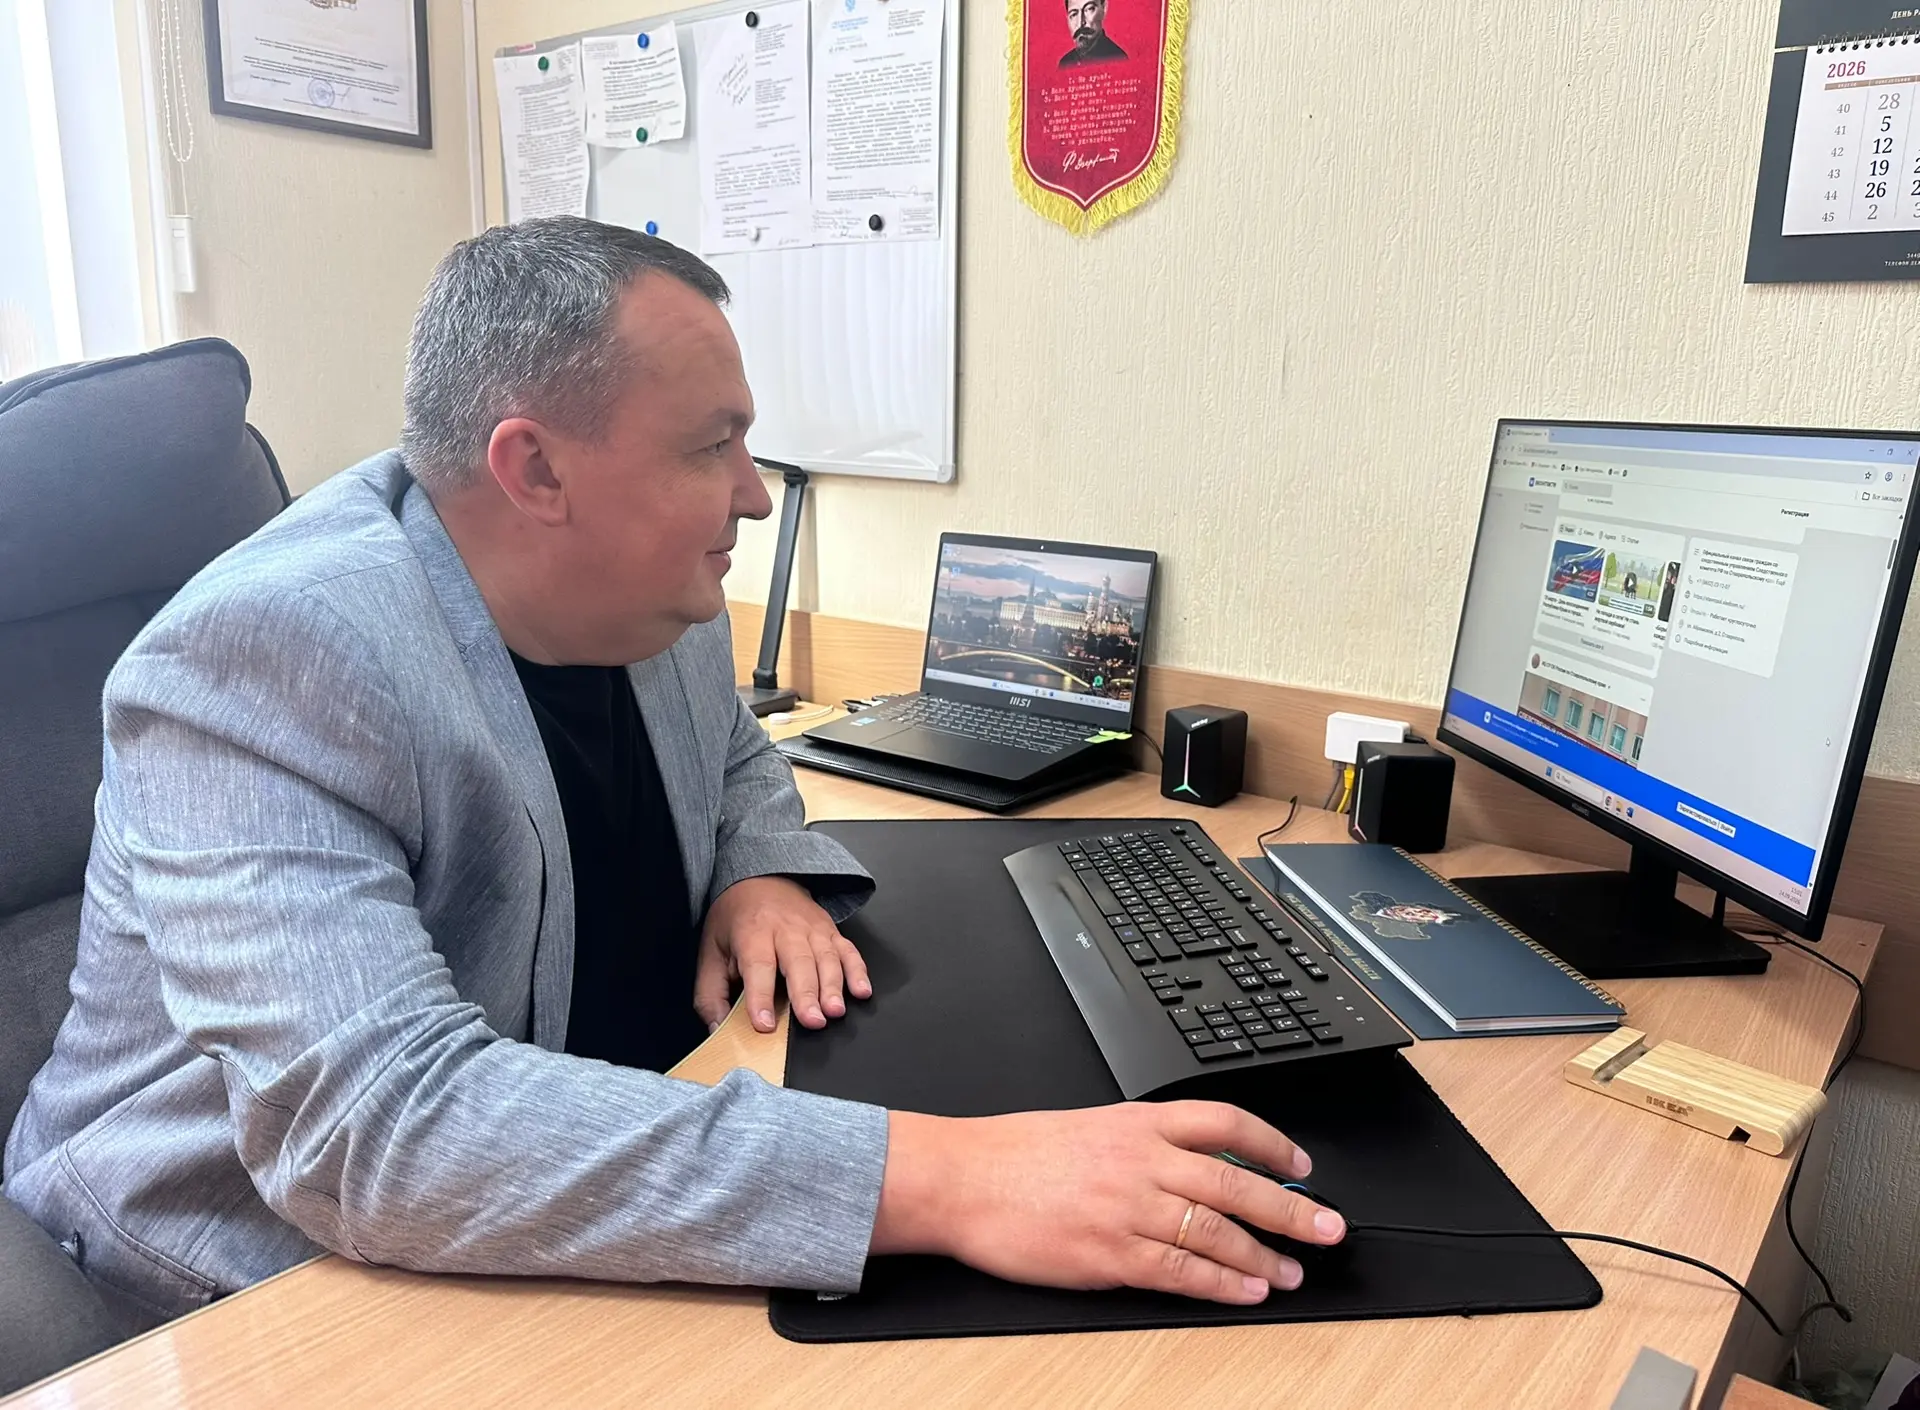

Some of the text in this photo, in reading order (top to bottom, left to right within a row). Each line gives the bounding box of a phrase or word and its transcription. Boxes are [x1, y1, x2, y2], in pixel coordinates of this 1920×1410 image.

[1890, 10, 1912, 20] ДЕНЬ
[1827, 60, 1866, 78] 2026
[1878, 92, 1900, 110] 28
[1836, 104, 1850, 114] 40
[1880, 116, 1892, 132] 5
[1834, 126, 1846, 136] 41
[1830, 147, 1844, 157] 42
[1872, 138, 1893, 154] 12
[1828, 169, 1840, 178] 43
[1869, 160, 1890, 176] 19
[1824, 190, 1838, 200] 44
[1865, 182, 1887, 198] 26
[1822, 212, 1834, 222] 45
[1867, 204, 1878, 220] 2
[1780, 508, 1810, 518] Регистрация
[1646, 1095, 1688, 1116] IKEA
